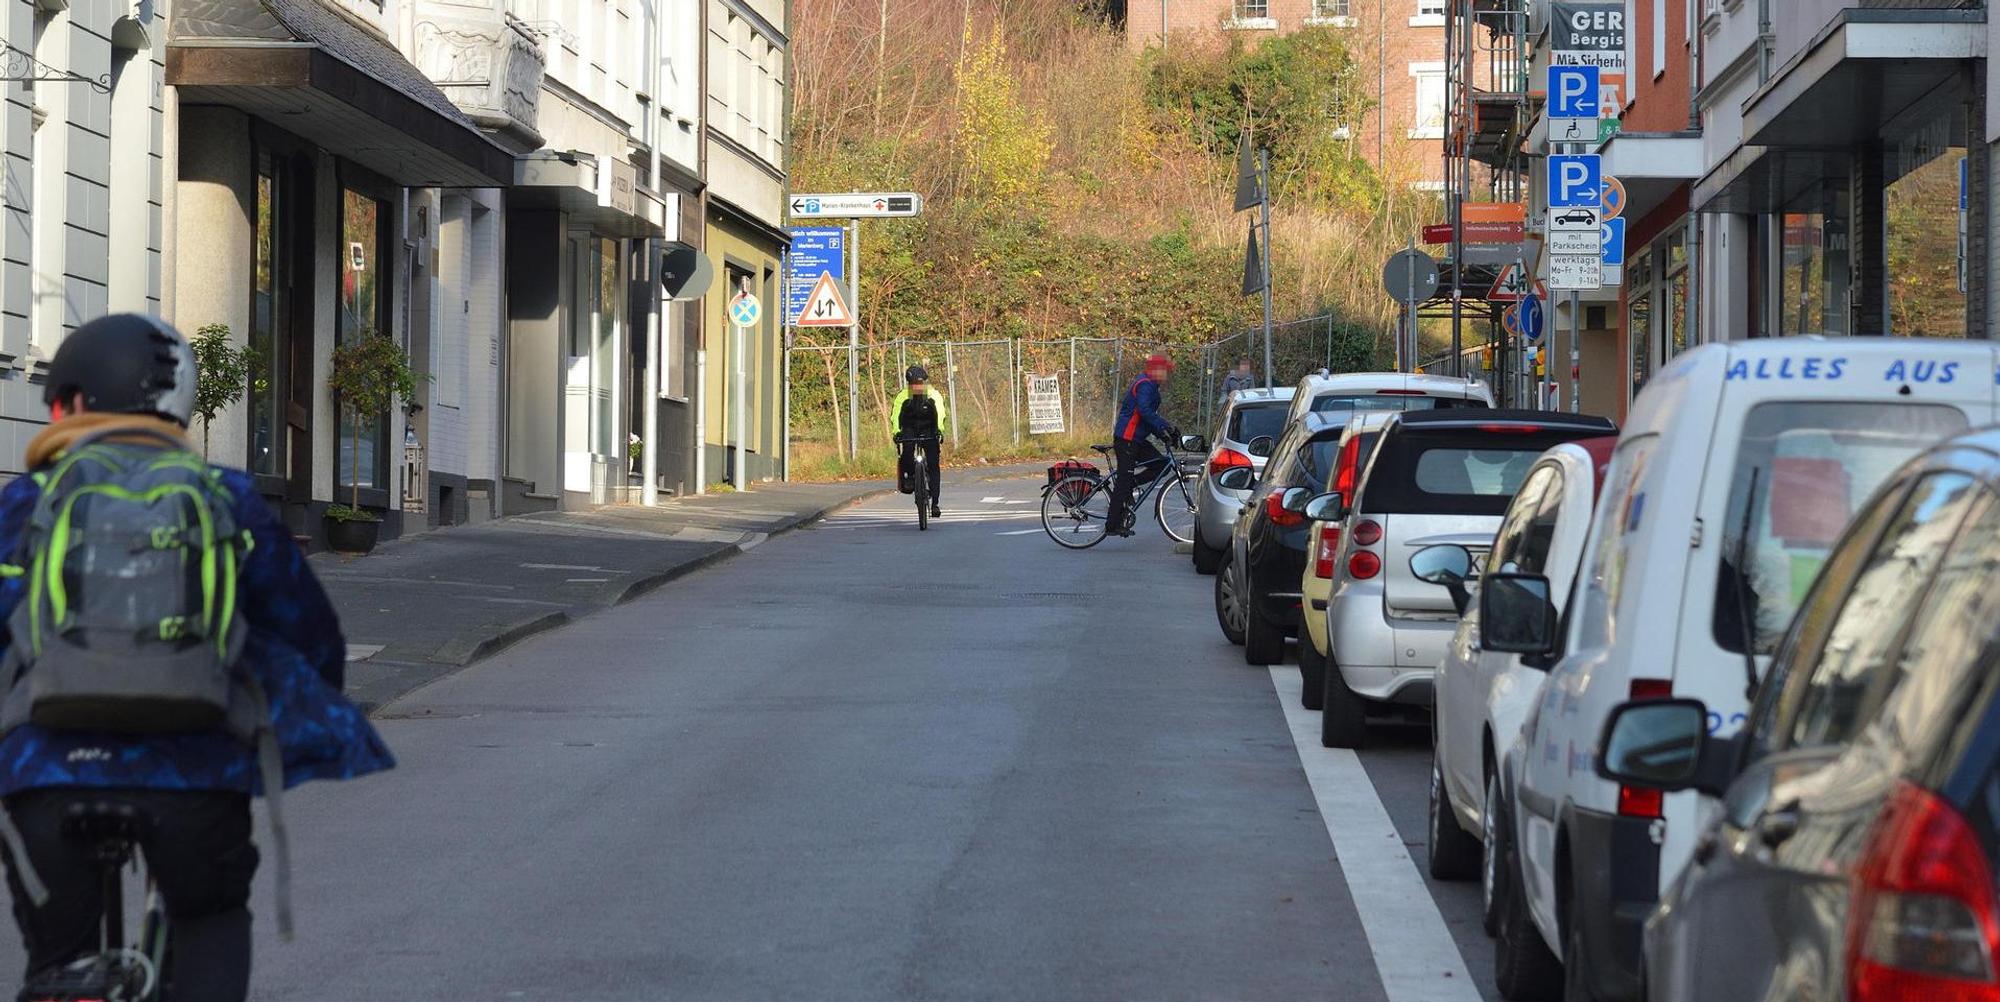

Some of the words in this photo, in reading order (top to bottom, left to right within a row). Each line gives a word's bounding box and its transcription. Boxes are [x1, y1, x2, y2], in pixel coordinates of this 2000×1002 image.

[1572, 11, 1623, 30] GER
[1571, 33, 1623, 48] Bergis
[1560, 72, 1587, 111] P
[1561, 162, 1588, 200] P
[1553, 242, 1597, 250] Parkschein
[1555, 256, 1595, 265] werktags
[1726, 358, 1848, 380] ALLES
[1884, 360, 1959, 383] AUS
